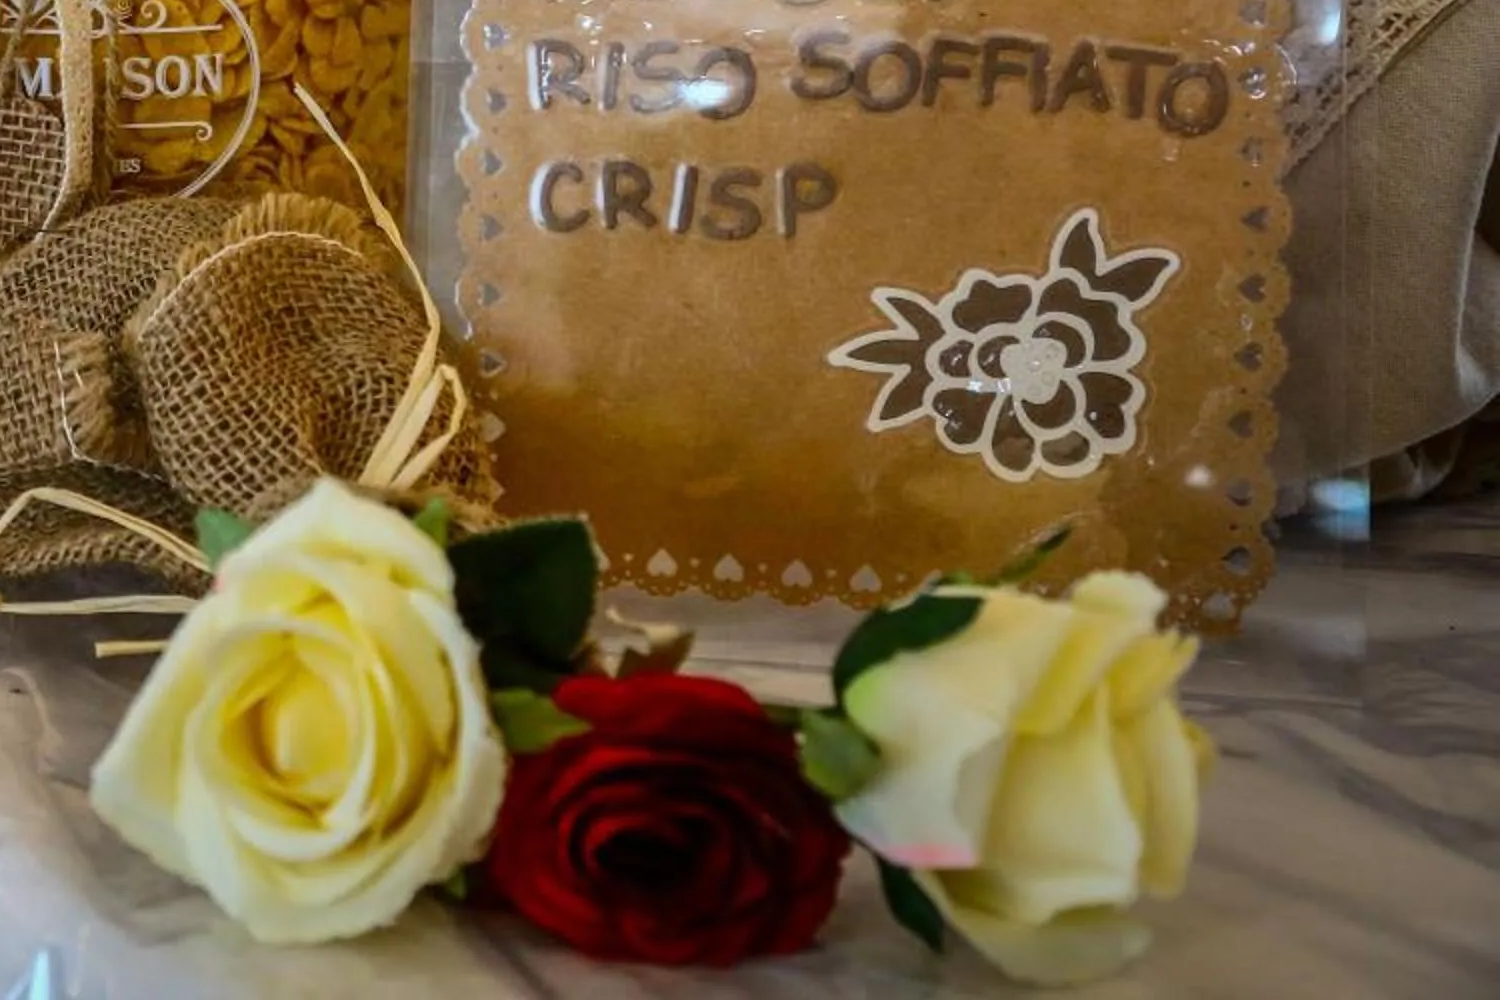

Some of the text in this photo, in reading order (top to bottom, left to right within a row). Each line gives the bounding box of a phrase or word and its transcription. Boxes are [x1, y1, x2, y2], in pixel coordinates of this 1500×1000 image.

[526, 30, 1230, 138] RISO SOFFIATO
[529, 160, 839, 241] CRISP
